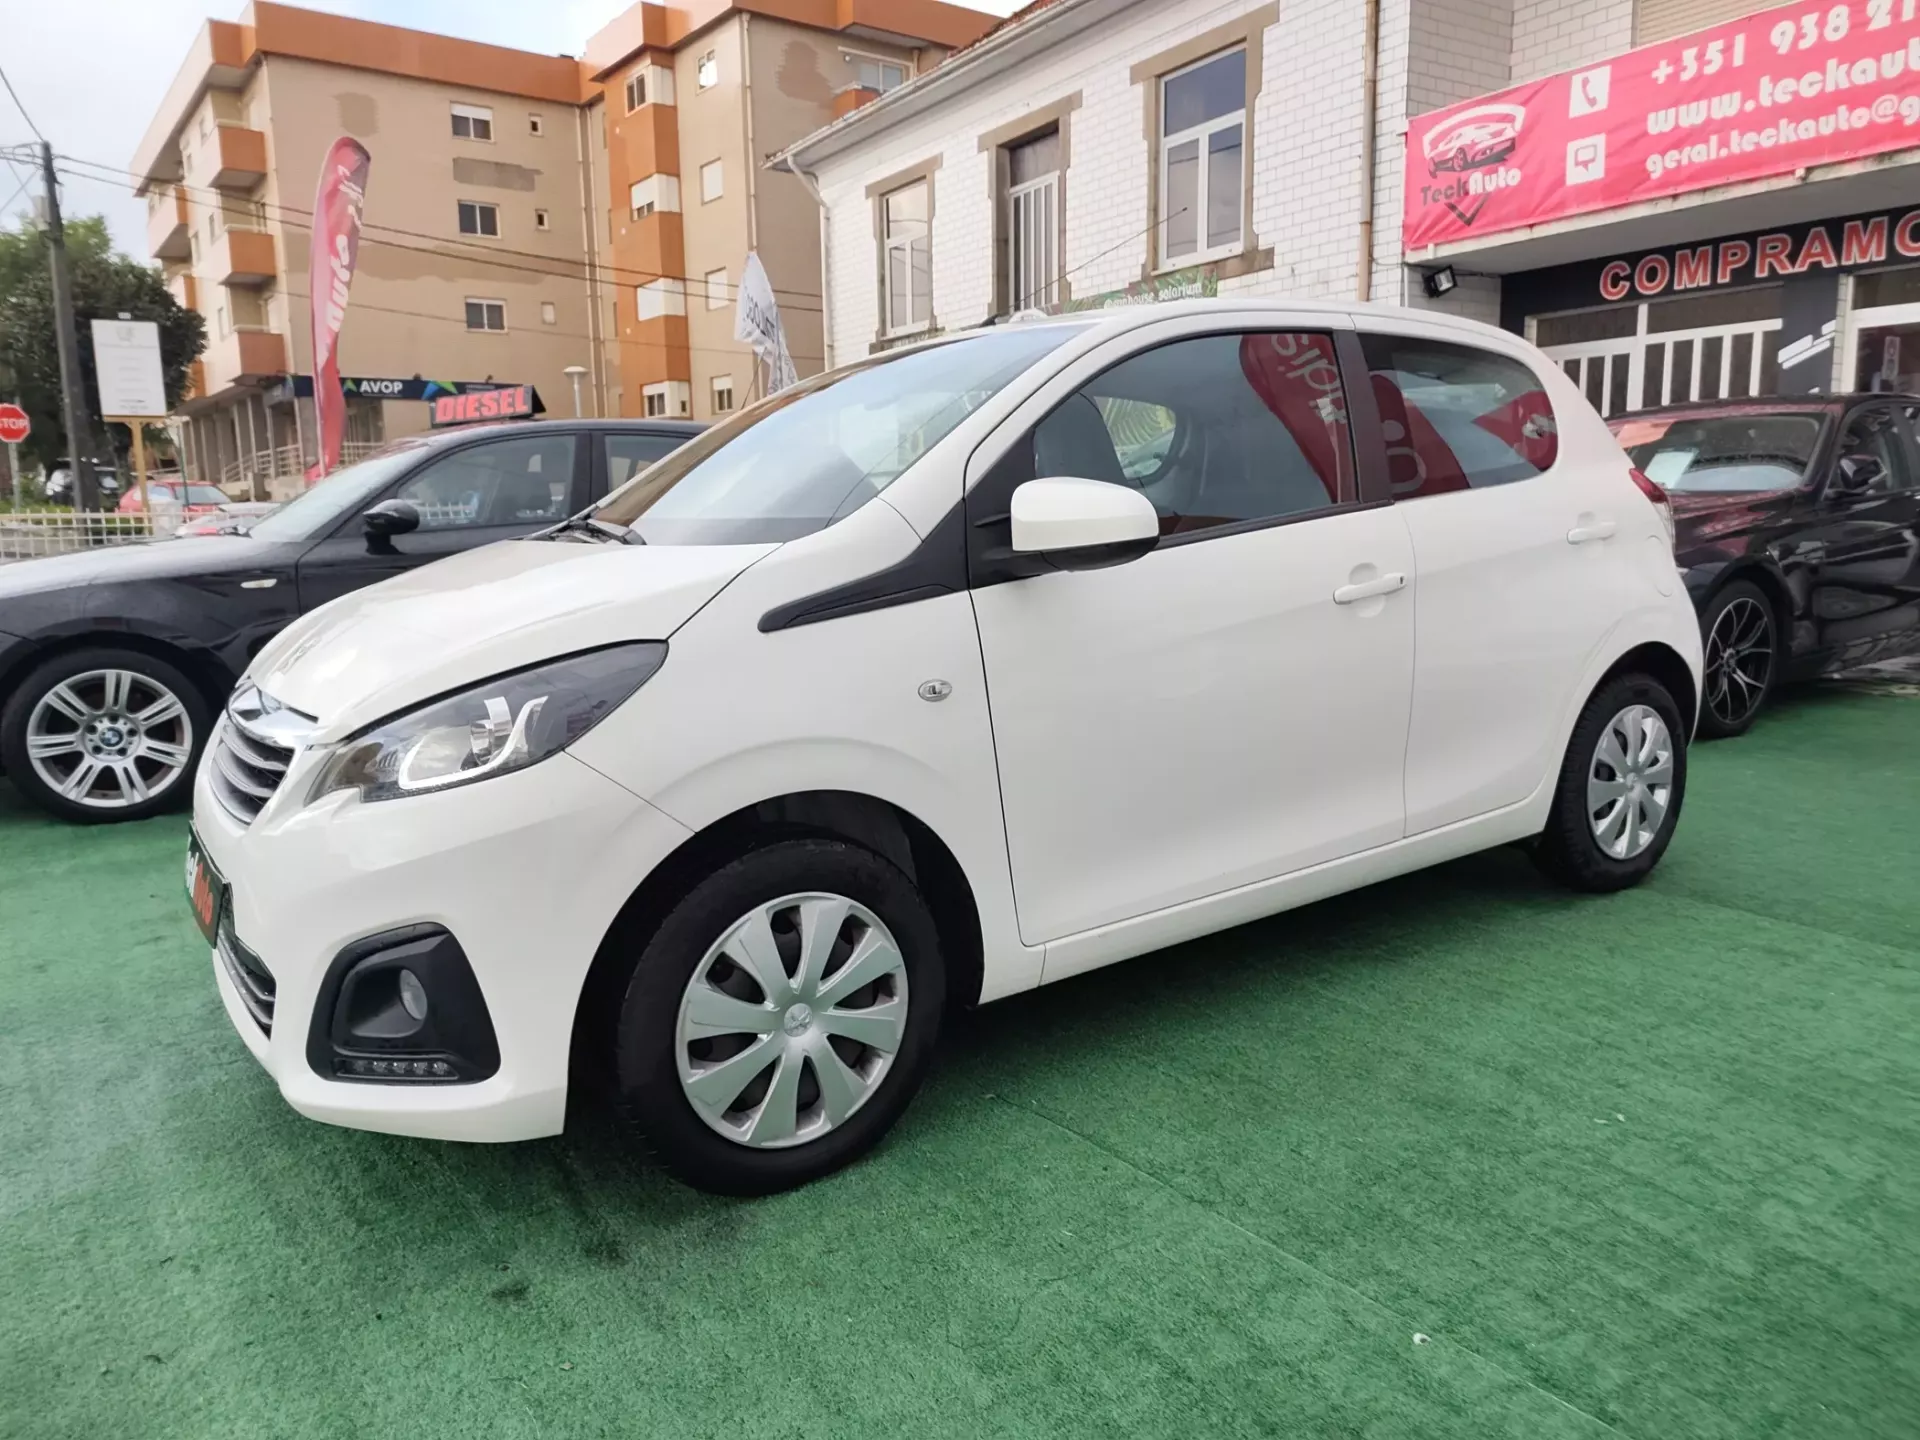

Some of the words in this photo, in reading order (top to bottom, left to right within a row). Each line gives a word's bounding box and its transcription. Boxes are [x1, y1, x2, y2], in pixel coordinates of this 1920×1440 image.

[1651, 33, 1746, 84] +351
[1769, 5, 1850, 54] 938
[1645, 94, 1920, 180] geral.teckauto@g
[359, 379, 403, 395] AVOP
[434, 387, 529, 423] DIESEL
